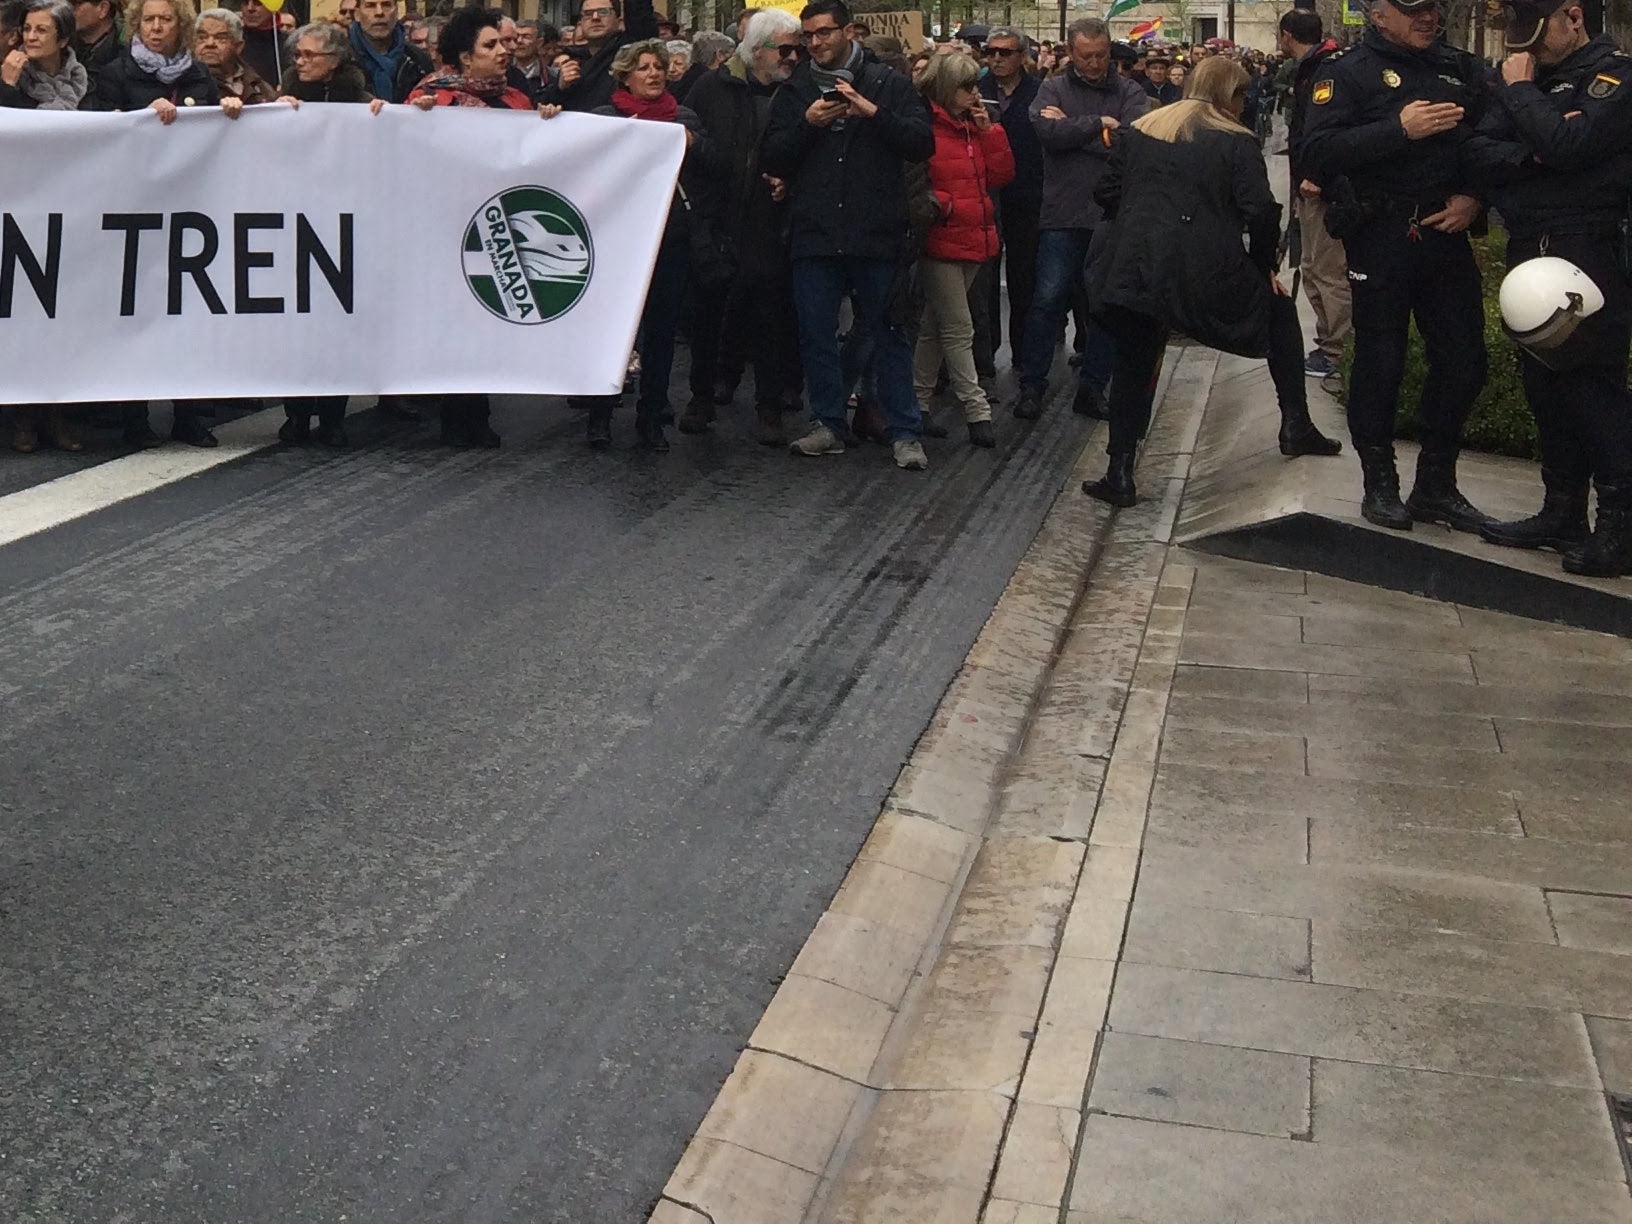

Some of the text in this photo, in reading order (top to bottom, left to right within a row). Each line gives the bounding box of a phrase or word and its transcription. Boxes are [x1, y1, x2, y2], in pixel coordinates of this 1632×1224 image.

[101, 211, 354, 315] TREN
[484, 205, 534, 320] GRANADA
[489, 252, 507, 288] MARCHA
